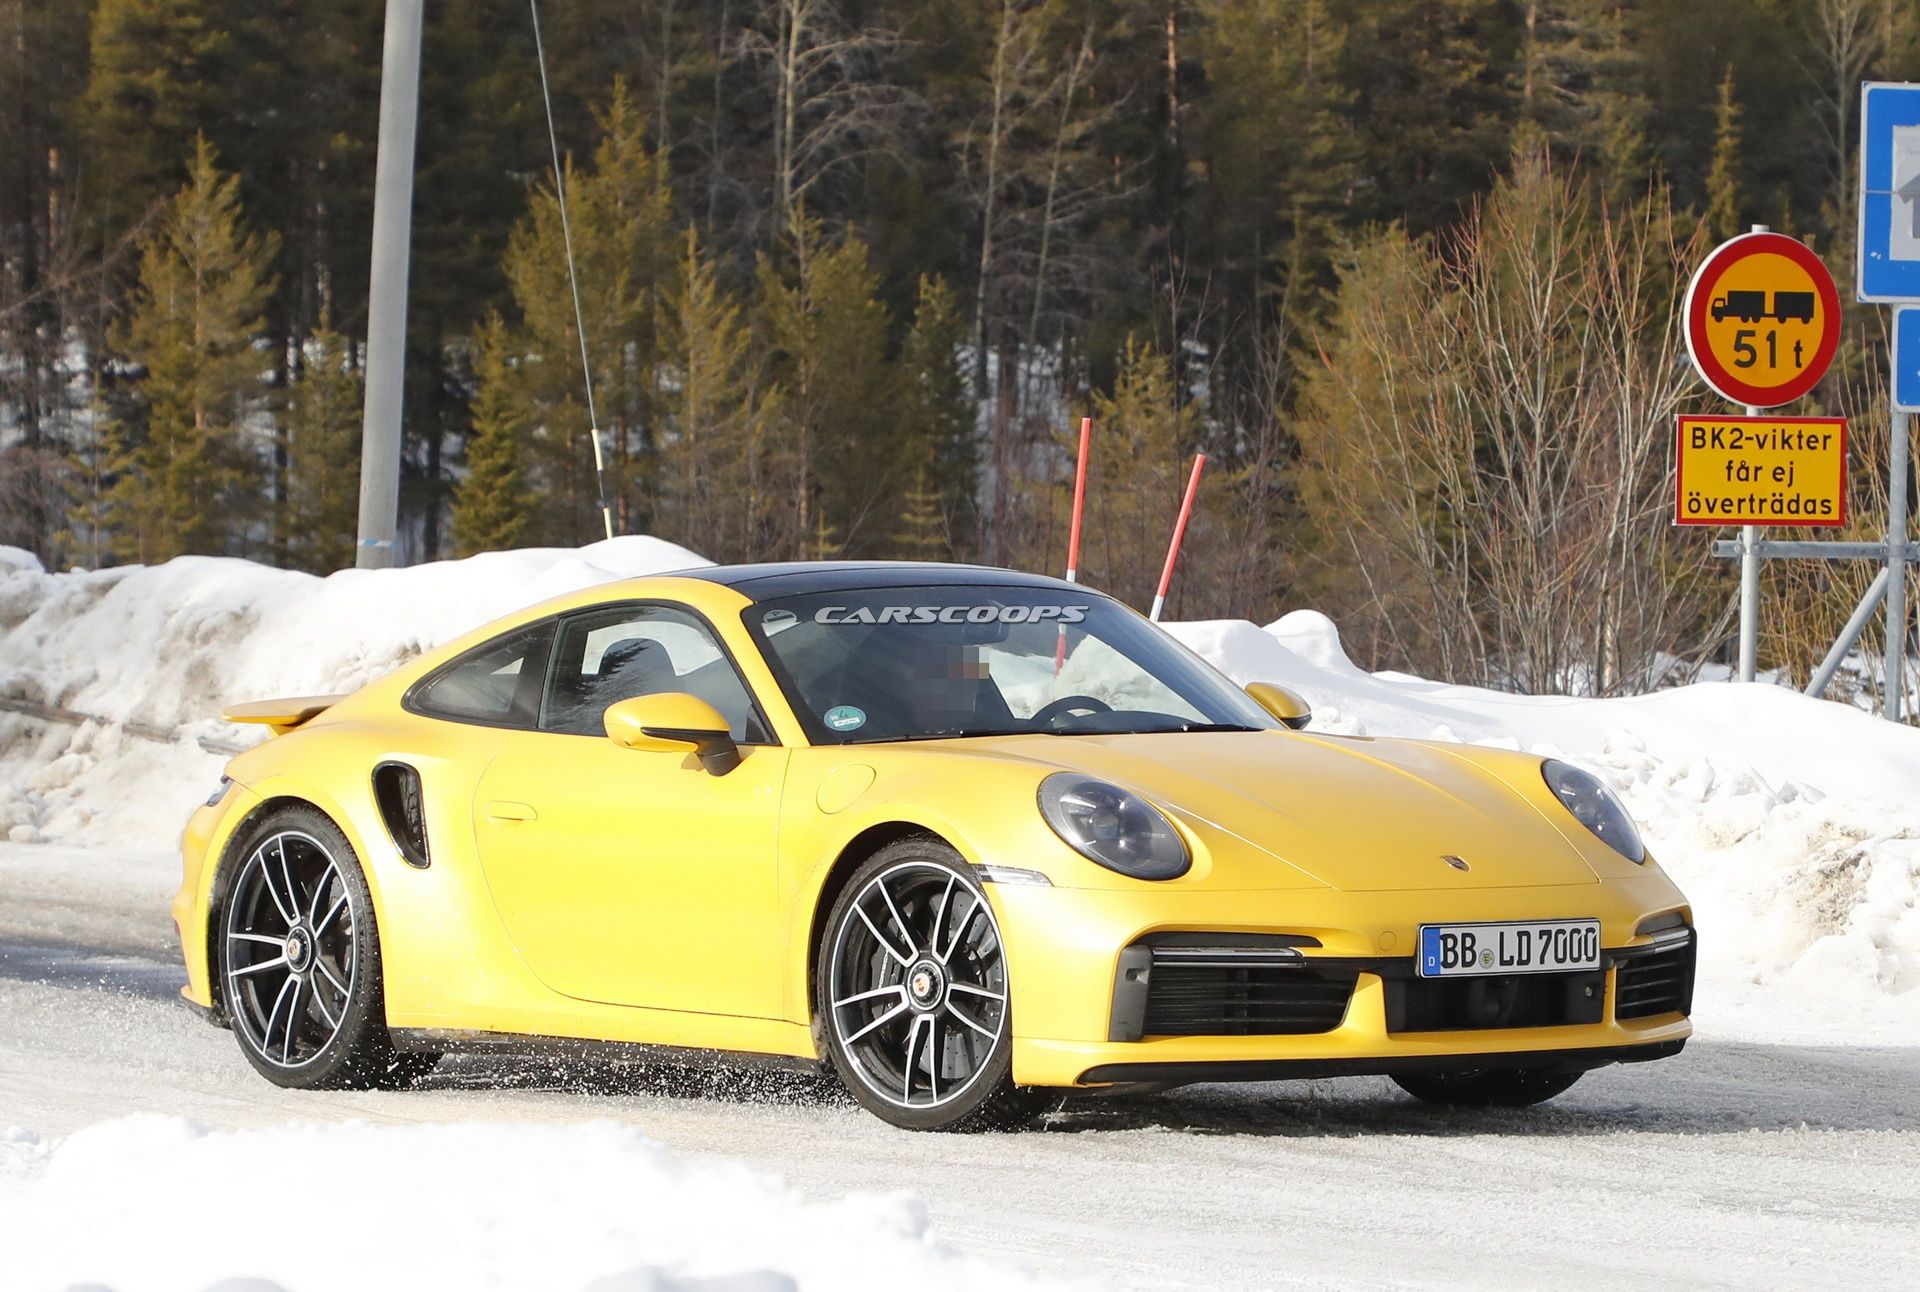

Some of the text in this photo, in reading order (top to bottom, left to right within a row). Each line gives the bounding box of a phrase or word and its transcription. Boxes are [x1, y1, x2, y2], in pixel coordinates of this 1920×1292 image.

[1733, 329, 1803, 368] 51 t
[1692, 427, 1831, 450] BK2-vikter
[1725, 459, 1794, 487] får ej
[1687, 491, 1832, 515] överträdas
[1427, 955, 1436, 967] D
[1440, 932, 1477, 968] BB
